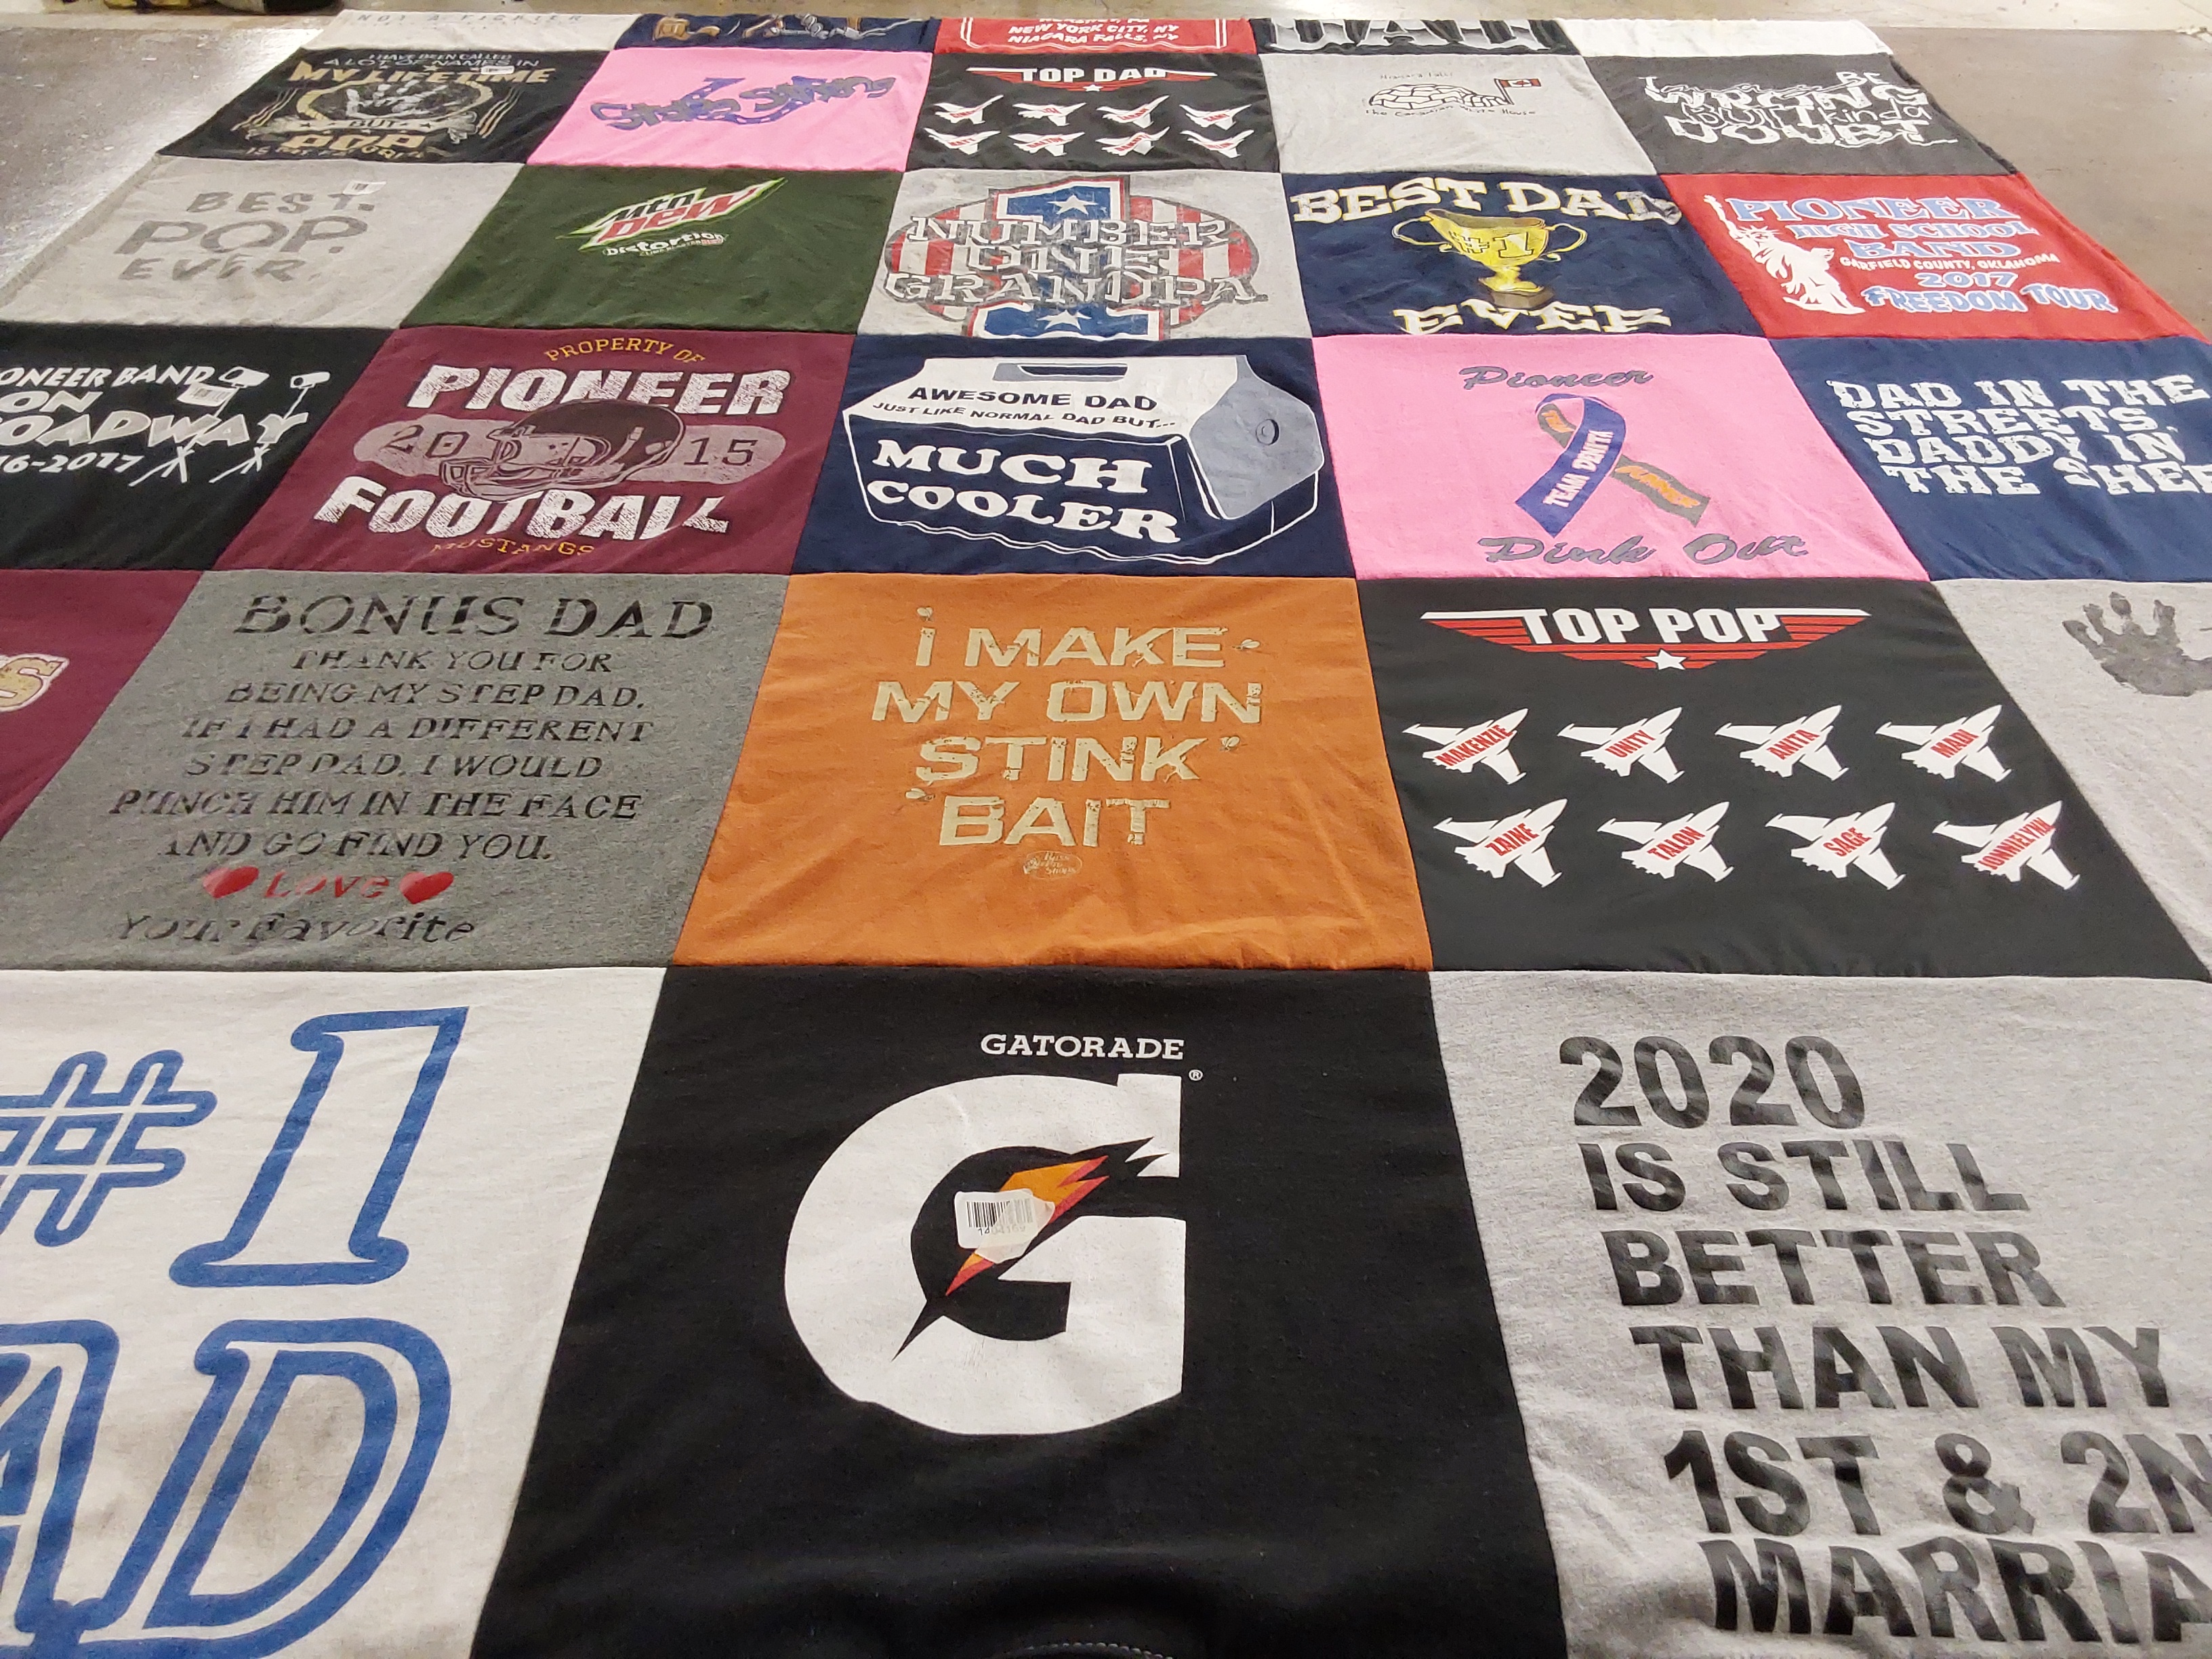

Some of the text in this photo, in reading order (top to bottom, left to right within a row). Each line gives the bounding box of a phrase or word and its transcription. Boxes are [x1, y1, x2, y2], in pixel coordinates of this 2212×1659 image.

[1008, 24, 1052, 34] NEW
[1056, 24, 1103, 34] YORK
[1153, 24, 1179, 33] NY
[1008, 33, 1088, 43] NIAGARA
[288, 61, 358, 82] MY
[366, 68, 555, 83] LIFETIME
[346, 58, 390, 67] LOT
[430, 58, 510, 67] NAMES
[1020, 67, 1168, 82] TOP DAD
[1836, 72, 1890, 87] BE
[1645, 85, 1929, 110] WRONG
[1819, 98, 1932, 125] kinda
[349, 119, 394, 129] BUT
[1664, 117, 1929, 145] DOUBT
[280, 134, 426, 150] POP
[1289, 176, 1683, 226] BEST DAD
[1725, 196, 2022, 222] PIONEER
[906, 216, 1231, 247] NUMBER
[1450, 230, 1534, 259] #1
[1785, 220, 2041, 240] HIGH SCHOOL
[966, 243, 1181, 275] ONE
[1839, 253, 2061, 271] GARFIELD COUNTY, OKLAHOMA
[1844, 239, 2022, 259] BAND
[885, 271, 1265, 304] GRANDPA
[1914, 272, 2020, 289] 2017
[1860, 284, 2119, 313] FREEDOM TOUR
[1392, 298, 1673, 334] EVER
[544, 337, 708, 365] PROPERTY OF
[112, 365, 215, 388] BAND
[406, 364, 792, 415] PIONEER
[1458, 364, 1655, 391] Pioneer
[1825, 373, 2212, 409] DAD IN THE
[0, 390, 104, 413] ON
[872, 401, 920, 416] JUST
[920, 404, 967, 417] LIKE
[969, 409, 1056, 424] NORMAL
[1060, 411, 1107, 428] DAD
[907, 386, 1158, 412] AWESOME DAD
[384, 426, 758, 469] 20 15
[1862, 432, 2187, 465] DADDY IN
[872, 438, 1154, 495] MUCH
[1880, 464, 2041, 495] THE
[1542, 472, 1582, 509] TEAM
[313, 475, 730, 541] FOOTBALL
[865, 480, 1182, 544] COOLER
[428, 537, 595, 556] MUSTANGS
[232, 593, 713, 640] BONUS DAD
[1521, 608, 1781, 644] TOP POP
[291, 649, 613, 673] THANK YOU FOR
[964, 626, 1229, 668] MAKE
[226, 681, 357, 703] BEING
[368, 681, 430, 704] MY
[436, 682, 546, 705] STEP
[872, 679, 1262, 724] MY OWN
[182, 716, 654, 743] IF I HAD A DIFFERENT
[1604, 729, 1658, 758] UNITY
[1766, 729, 1820, 761] ANITA
[1930, 728, 1980, 759] MADI
[915, 736, 1208, 785] STINK
[1433, 724, 1515, 767] MAKENZIE
[186, 752, 603, 779] STEP I WOULD
[108, 789, 647, 820] PUNCH HIM IN THE FACE
[939, 796, 1171, 848] BAIT
[162, 830, 253, 857] AND
[262, 830, 333, 857] GO
[335, 830, 442, 858] FIND
[1483, 822, 1540, 857] ZAINE
[1646, 826, 1706, 861] TALON
[1822, 827, 1872, 858] SAGE
[119, 909, 477, 944] Your Favorite
[981, 1033, 1185, 1061] GATORADE
[1559, 1035, 1866, 1130] 2020
[1578, 1139, 2030, 1212] IS STILL
[1601, 1229, 2066, 1307] BETTER
[1629, 1325, 2170, 1410] THAN MY
[1664, 1430, 1881, 1536] 1ST
[1934, 1433, 2036, 1534] &
[1697, 1536, 2212, 1643] MARRIA
